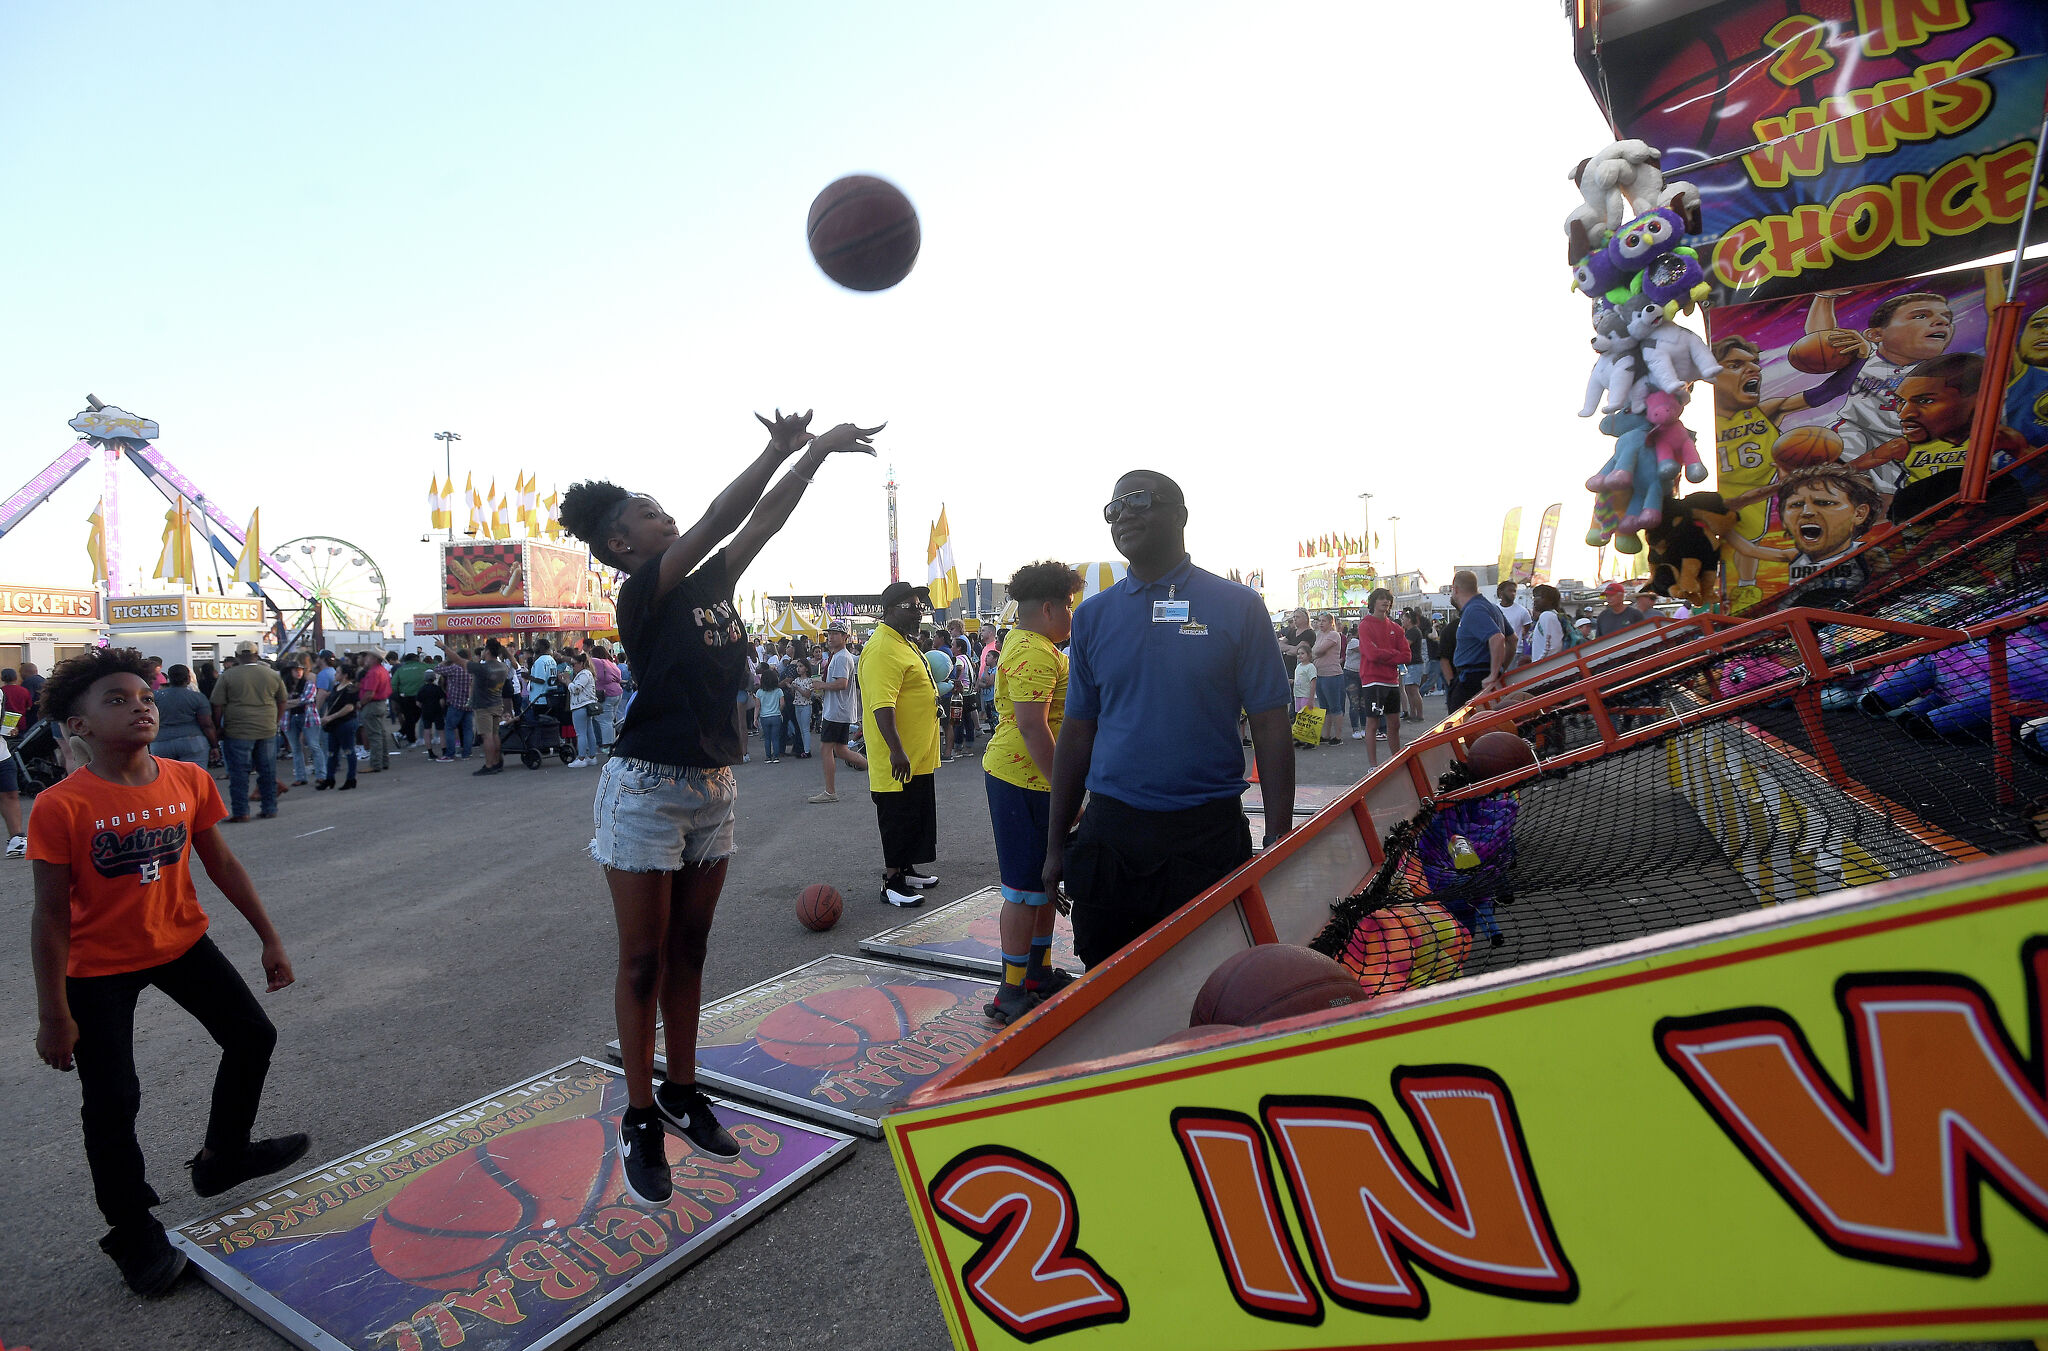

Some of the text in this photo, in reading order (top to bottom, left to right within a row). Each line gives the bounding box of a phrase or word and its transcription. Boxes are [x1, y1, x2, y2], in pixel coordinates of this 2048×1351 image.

[1764, 0, 1972, 85] 2 IN
[1742, 37, 2016, 188] WINS
[1712, 140, 2048, 289] CHOICE
[1879, 390, 1899, 411] 3
[1716, 420, 1768, 442] KERS
[1717, 441, 1763, 472] 16
[1909, 450, 1968, 468] LAKER
[0, 591, 92, 616] ICKETS
[112, 603, 179, 619] TICKETS
[190, 601, 258, 619] TICKETS
[447, 614, 501, 627] CORN DOGS
[515, 614, 556, 625] COLD DRIN
[95, 802, 187, 830] HOUSTON
[92, 820, 187, 858] Astros
[139, 858, 161, 884] H
[698, 998, 748, 1021] FOU
[575, 1072, 614, 1090] DO
[525, 1084, 582, 1111] YOU
[422, 1101, 505, 1138] LINE
[307, 1138, 417, 1183] FOUL
[381, 1138, 465, 1181] WHAT
[188, 1189, 300, 1240] LINE
[927, 1143, 1130, 1343] 2
[1171, 1063, 1580, 1327] IN
